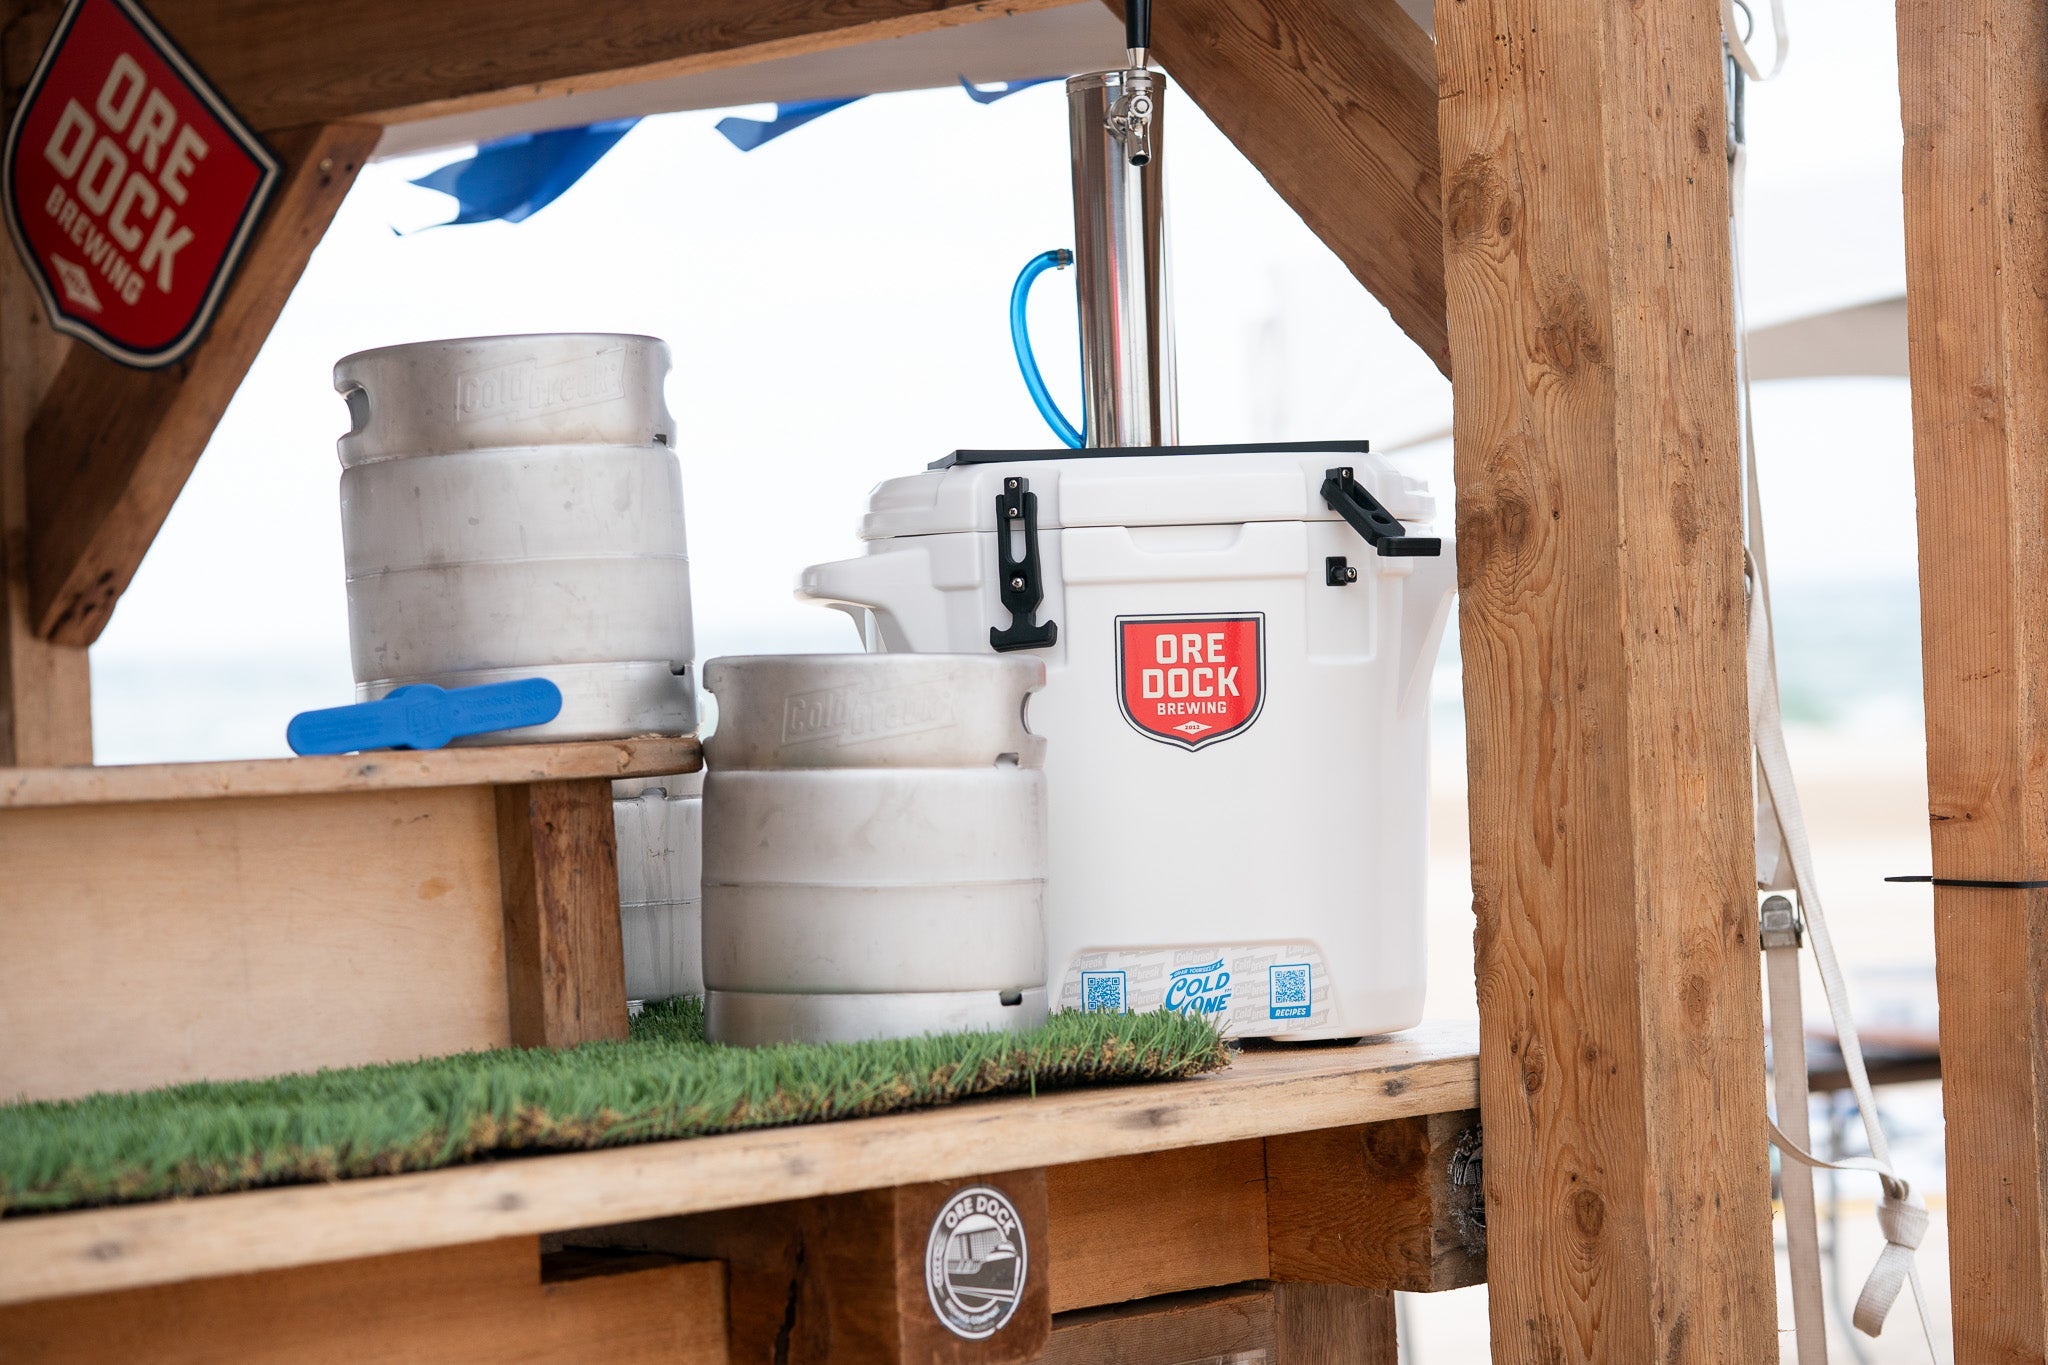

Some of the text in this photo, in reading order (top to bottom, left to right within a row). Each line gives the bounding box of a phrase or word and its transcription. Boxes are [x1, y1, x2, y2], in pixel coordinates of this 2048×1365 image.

[96, 52, 209, 206] ORE
[44, 97, 195, 295] DOCK
[44, 183, 146, 306] BREWING
[1156, 632, 1226, 664] ORE
[1142, 666, 1240, 699] DOCK
[1157, 701, 1227, 715] BREWING
[1166, 972, 1230, 1011] COLD
[1182, 993, 1231, 1016] ONE
[1275, 1007, 1307, 1017] RECIPES
[945, 1196, 1016, 1236] ORE DOCK
